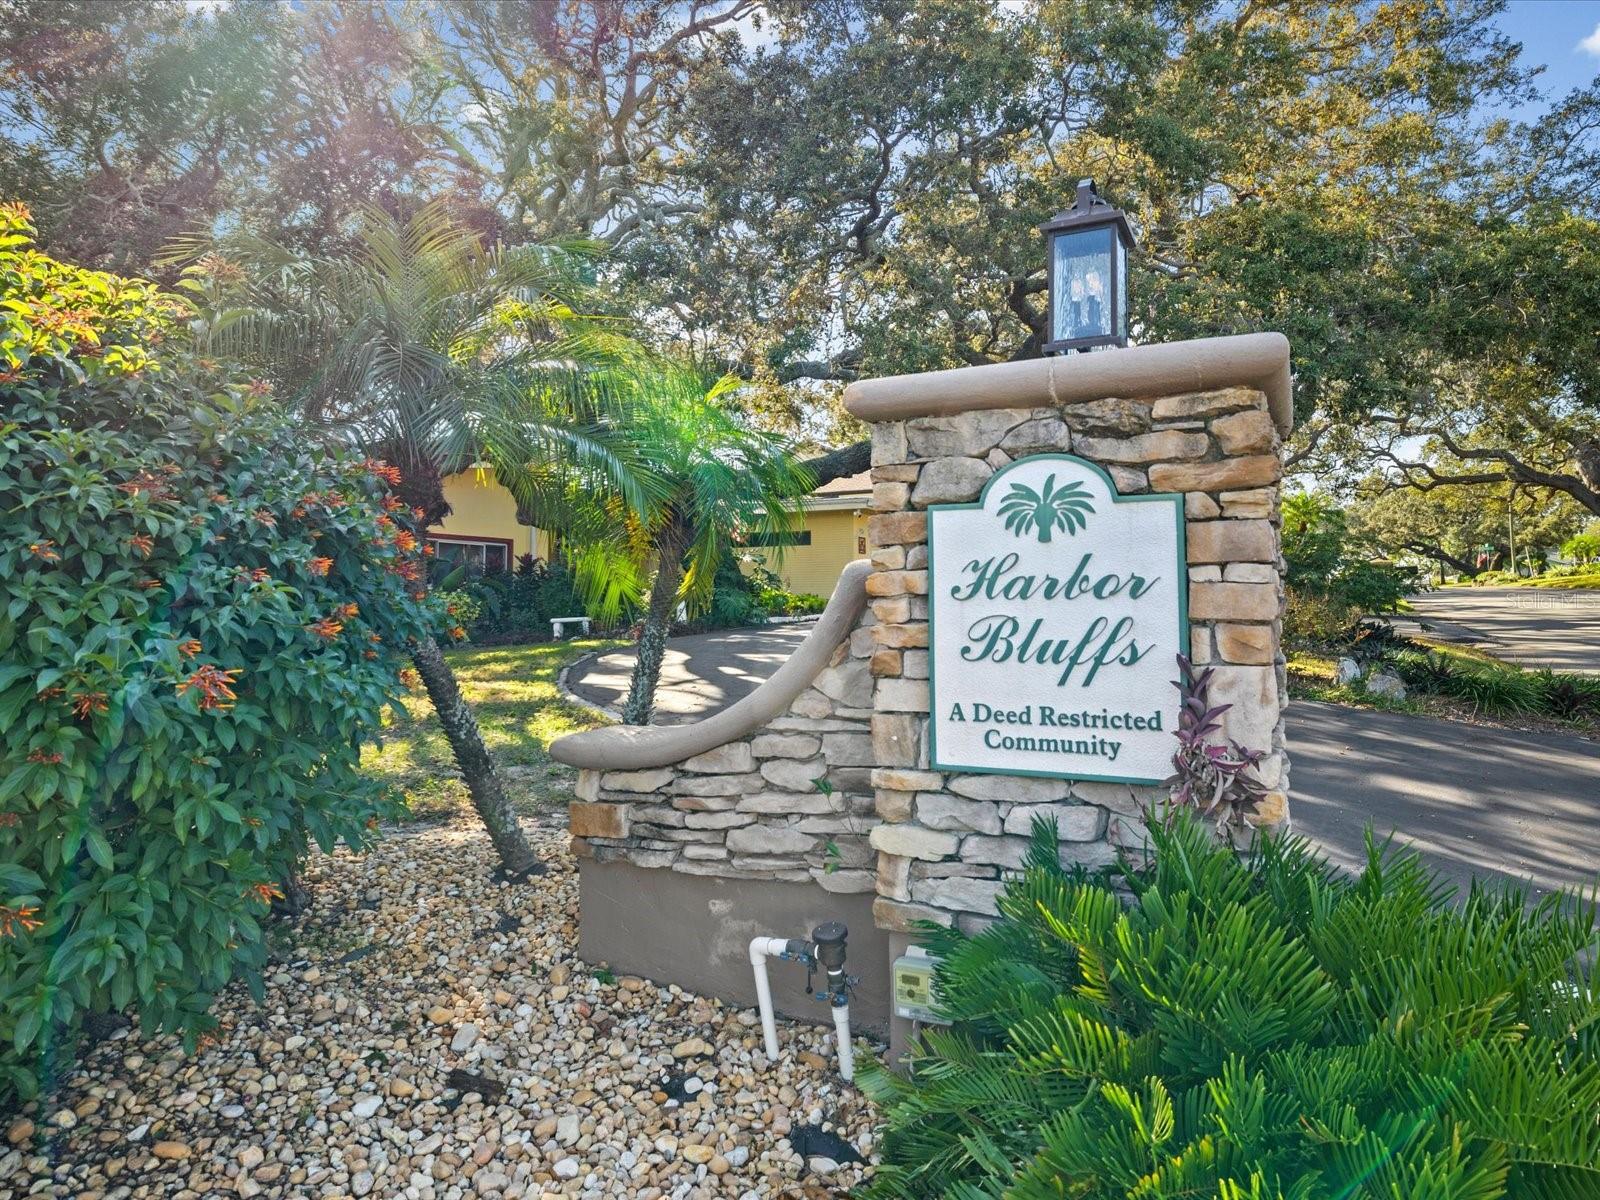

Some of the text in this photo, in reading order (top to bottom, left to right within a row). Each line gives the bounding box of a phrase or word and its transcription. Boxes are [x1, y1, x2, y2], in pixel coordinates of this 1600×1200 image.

[951, 552, 1160, 601] Harbor
[960, 615, 1155, 687] Bluffs
[949, 702, 1162, 732] A Deed Restricted
[984, 729, 1121, 760] Community
